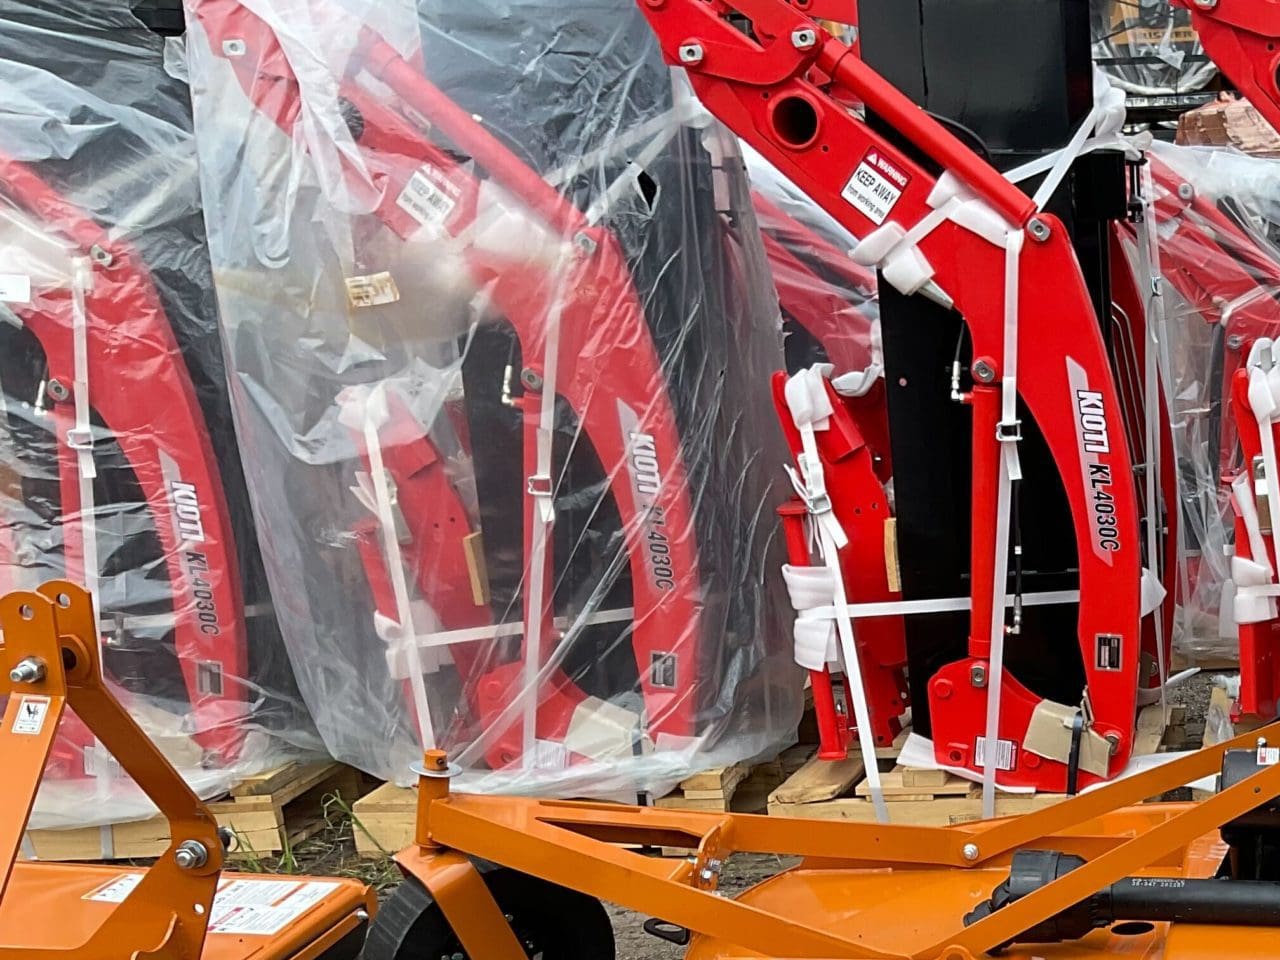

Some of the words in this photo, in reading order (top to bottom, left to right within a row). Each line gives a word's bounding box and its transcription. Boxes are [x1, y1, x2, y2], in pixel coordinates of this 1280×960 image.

[855, 168, 876, 187] KEEP
[872, 183, 897, 205] AWAY
[877, 157, 908, 187] WARNING
[1077, 390, 1110, 453] KIOTI
[629, 431, 662, 495] KIOTI
[171, 481, 205, 543] KIOTI
[1088, 463, 1121, 551] KL4030C
[185, 550, 221, 636] KL4030C
